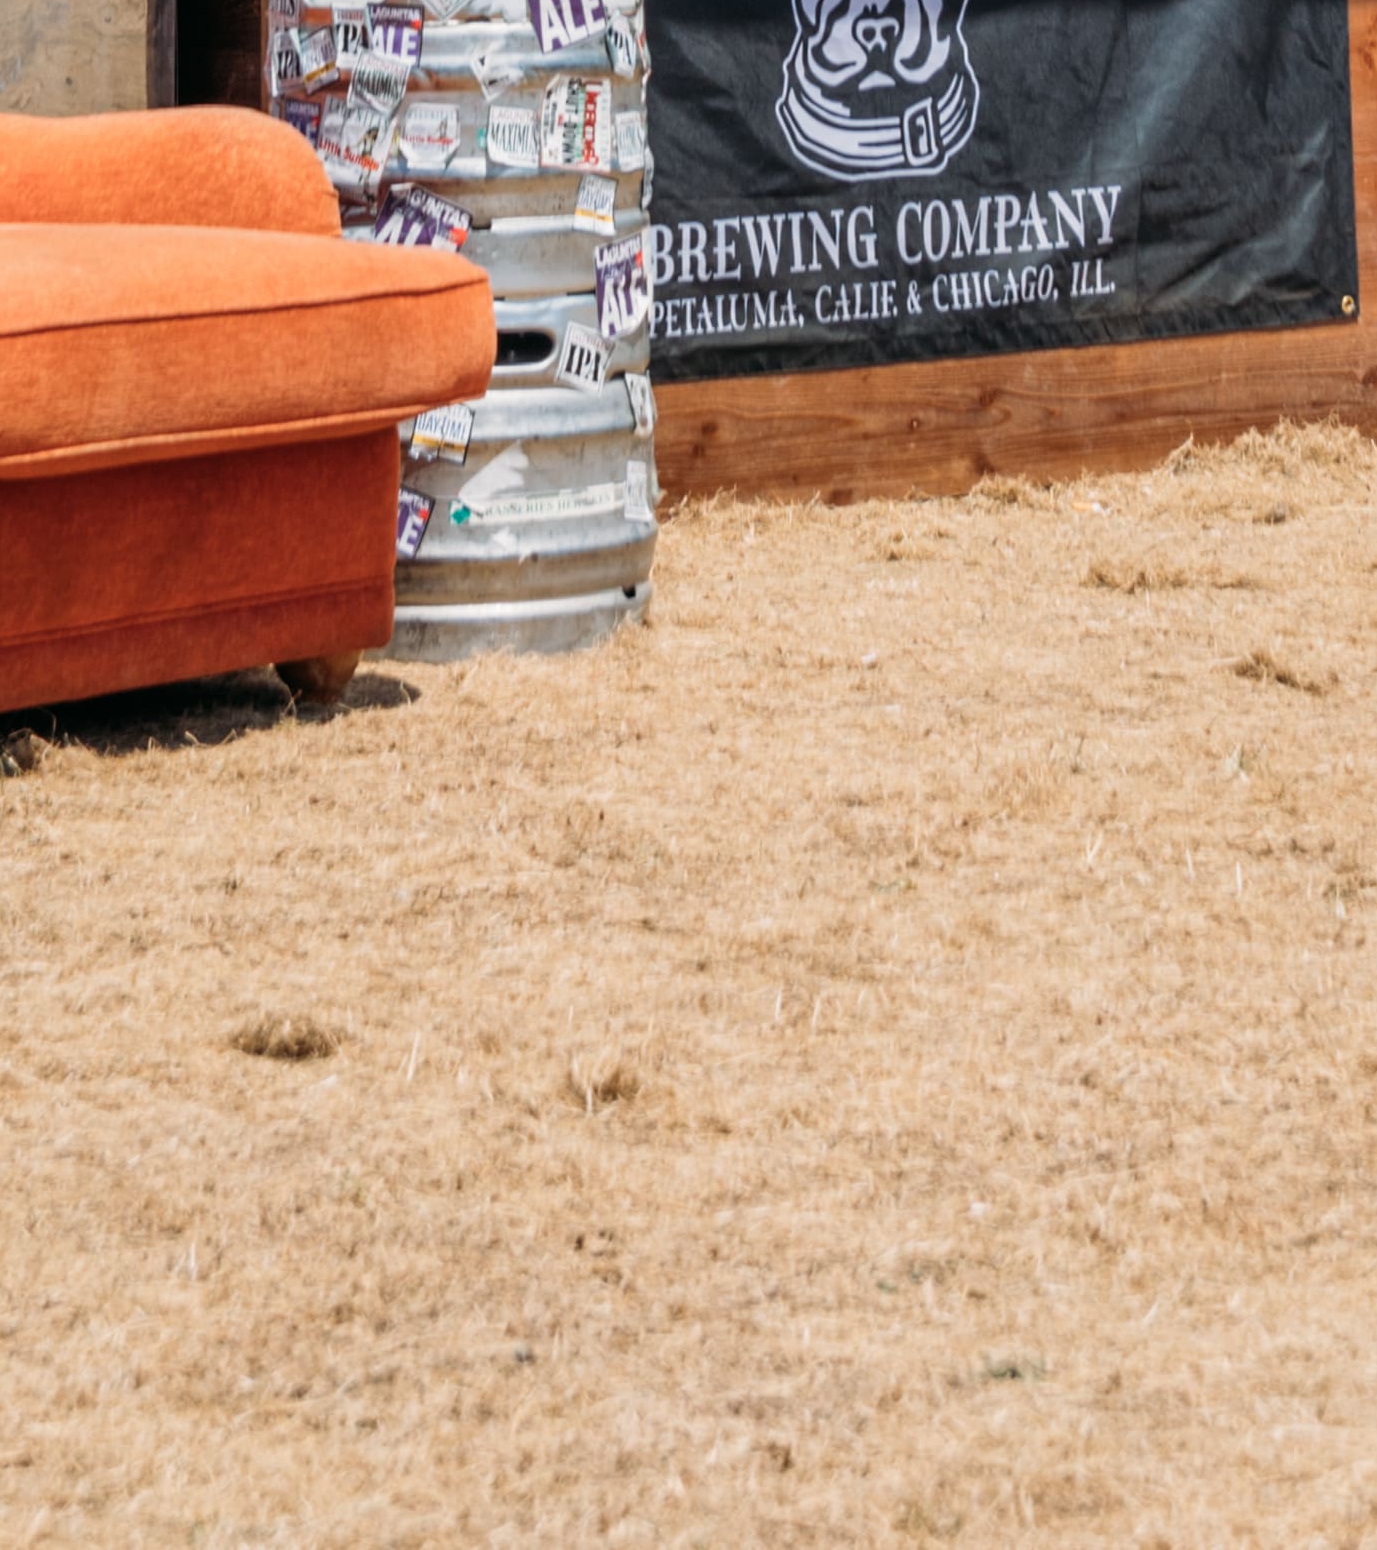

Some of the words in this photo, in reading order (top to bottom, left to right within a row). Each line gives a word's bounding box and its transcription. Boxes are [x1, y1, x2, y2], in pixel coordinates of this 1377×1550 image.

[372, 24, 420, 65] ALE
[648, 205, 878, 285] BREWING
[896, 185, 1122, 266] COMPANY
[648, 288, 806, 340] PETALUMA,
[815, 281, 898, 325] CALIF.
[907, 284, 922, 314] &
[932, 268, 1059, 315] CHICAGO,
[1070, 259, 1116, 297] ILL.
[565, 343, 602, 382] IPA
